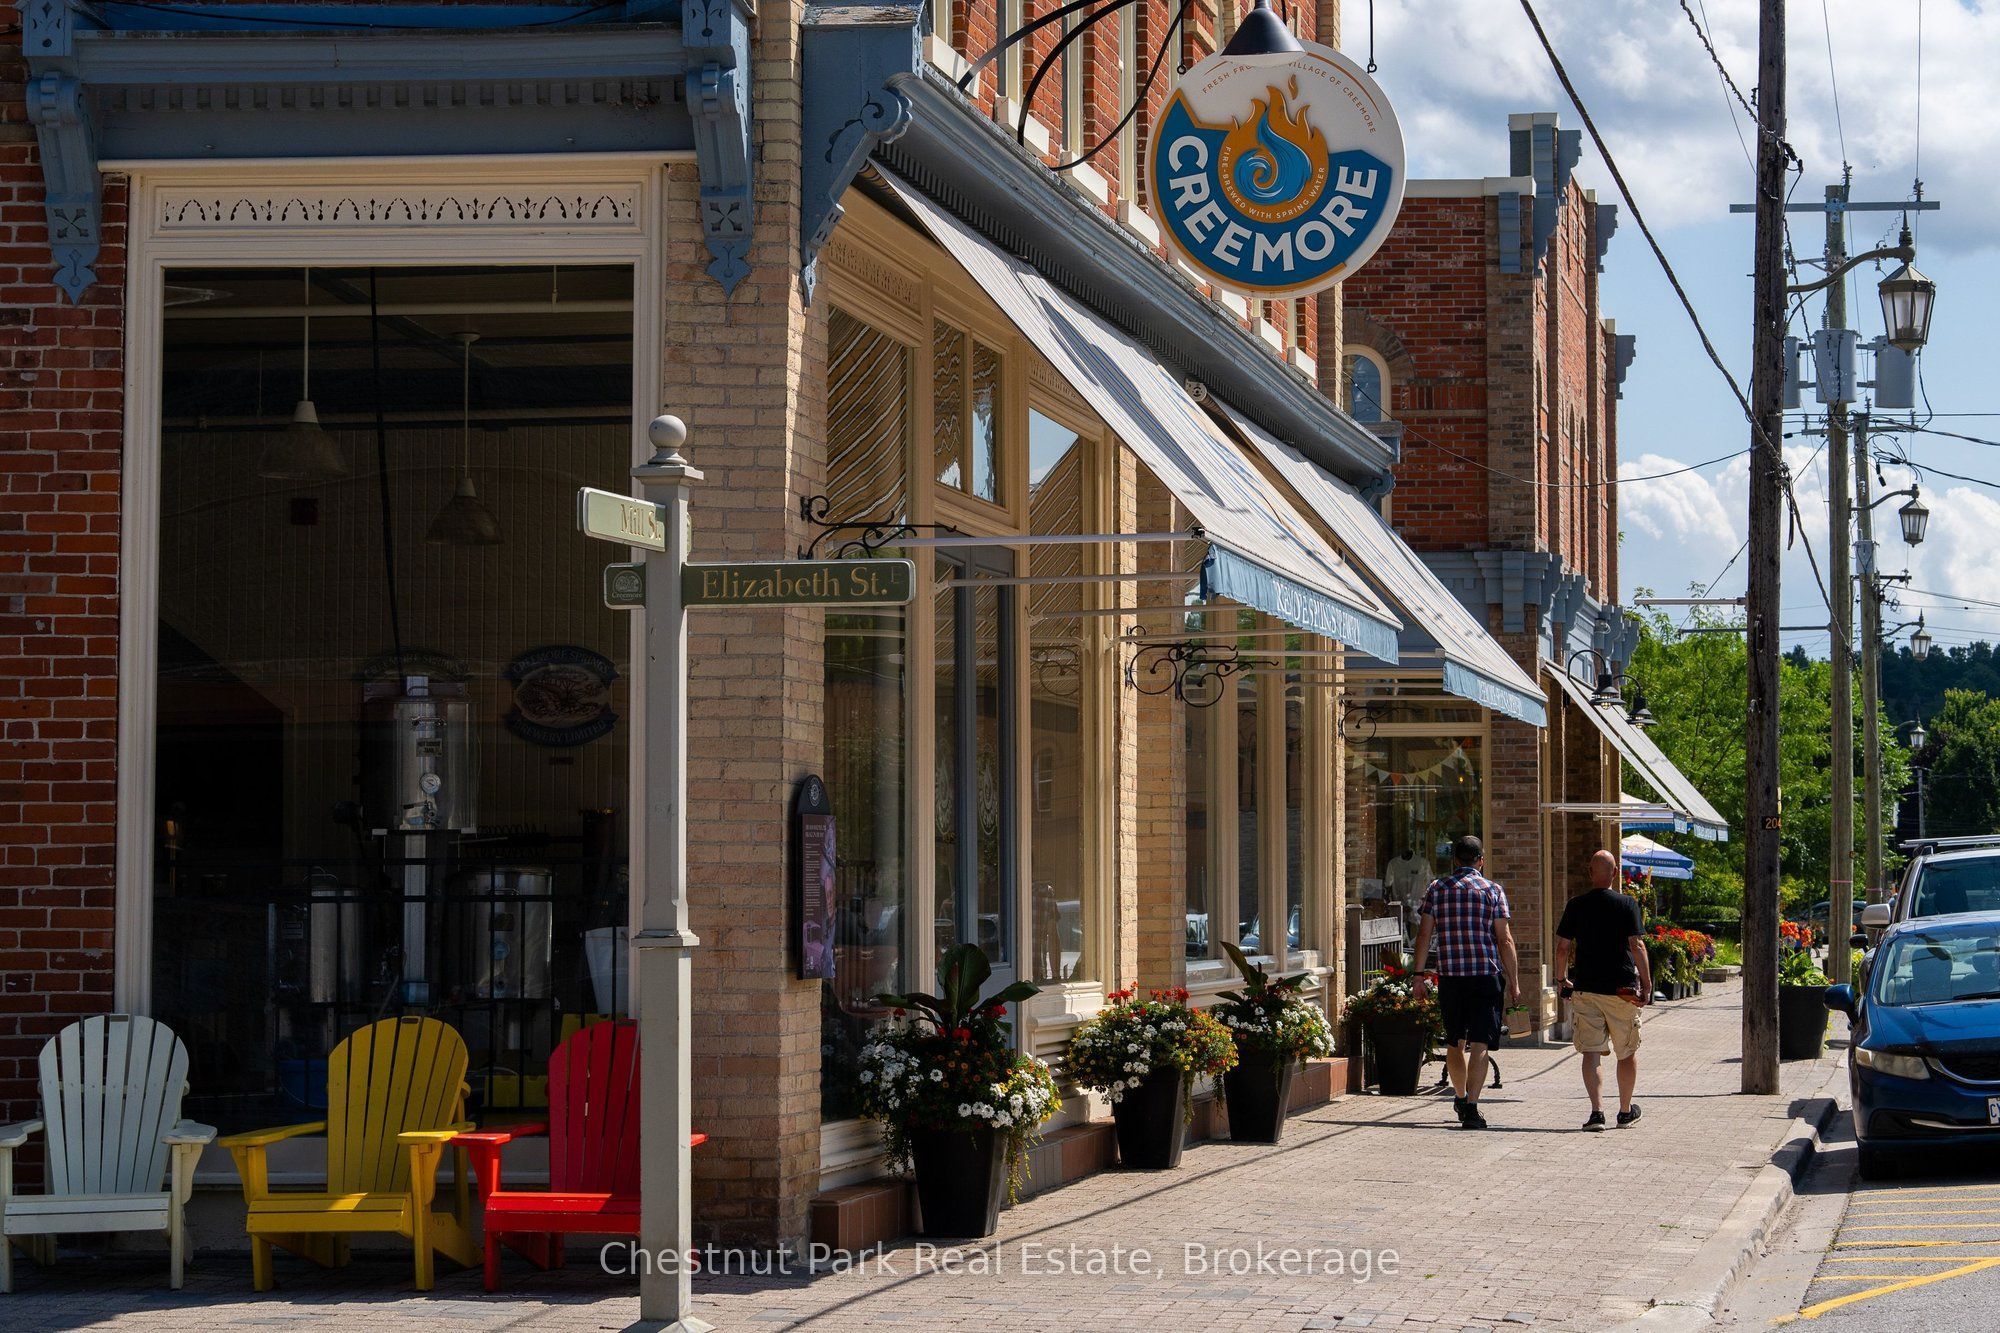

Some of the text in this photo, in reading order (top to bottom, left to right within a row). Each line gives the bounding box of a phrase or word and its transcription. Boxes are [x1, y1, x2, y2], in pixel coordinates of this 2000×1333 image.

[1202, 72, 1230, 94] FRESH
[1288, 61, 1327, 78] VILLAGE
[1329, 76, 1342, 86] OF
[1342, 86, 1376, 133] CREEMORE
[1221, 146, 1325, 219] FIRE-BREWED WITH SPRING WATER
[1168, 135, 1378, 272] CREEMORE
[620, 503, 662, 541] Mill St.
[702, 565, 902, 600] Elizabeth St. E
[569, 649, 610, 674] SPRINGS
[564, 719, 607, 743] LIMITED
